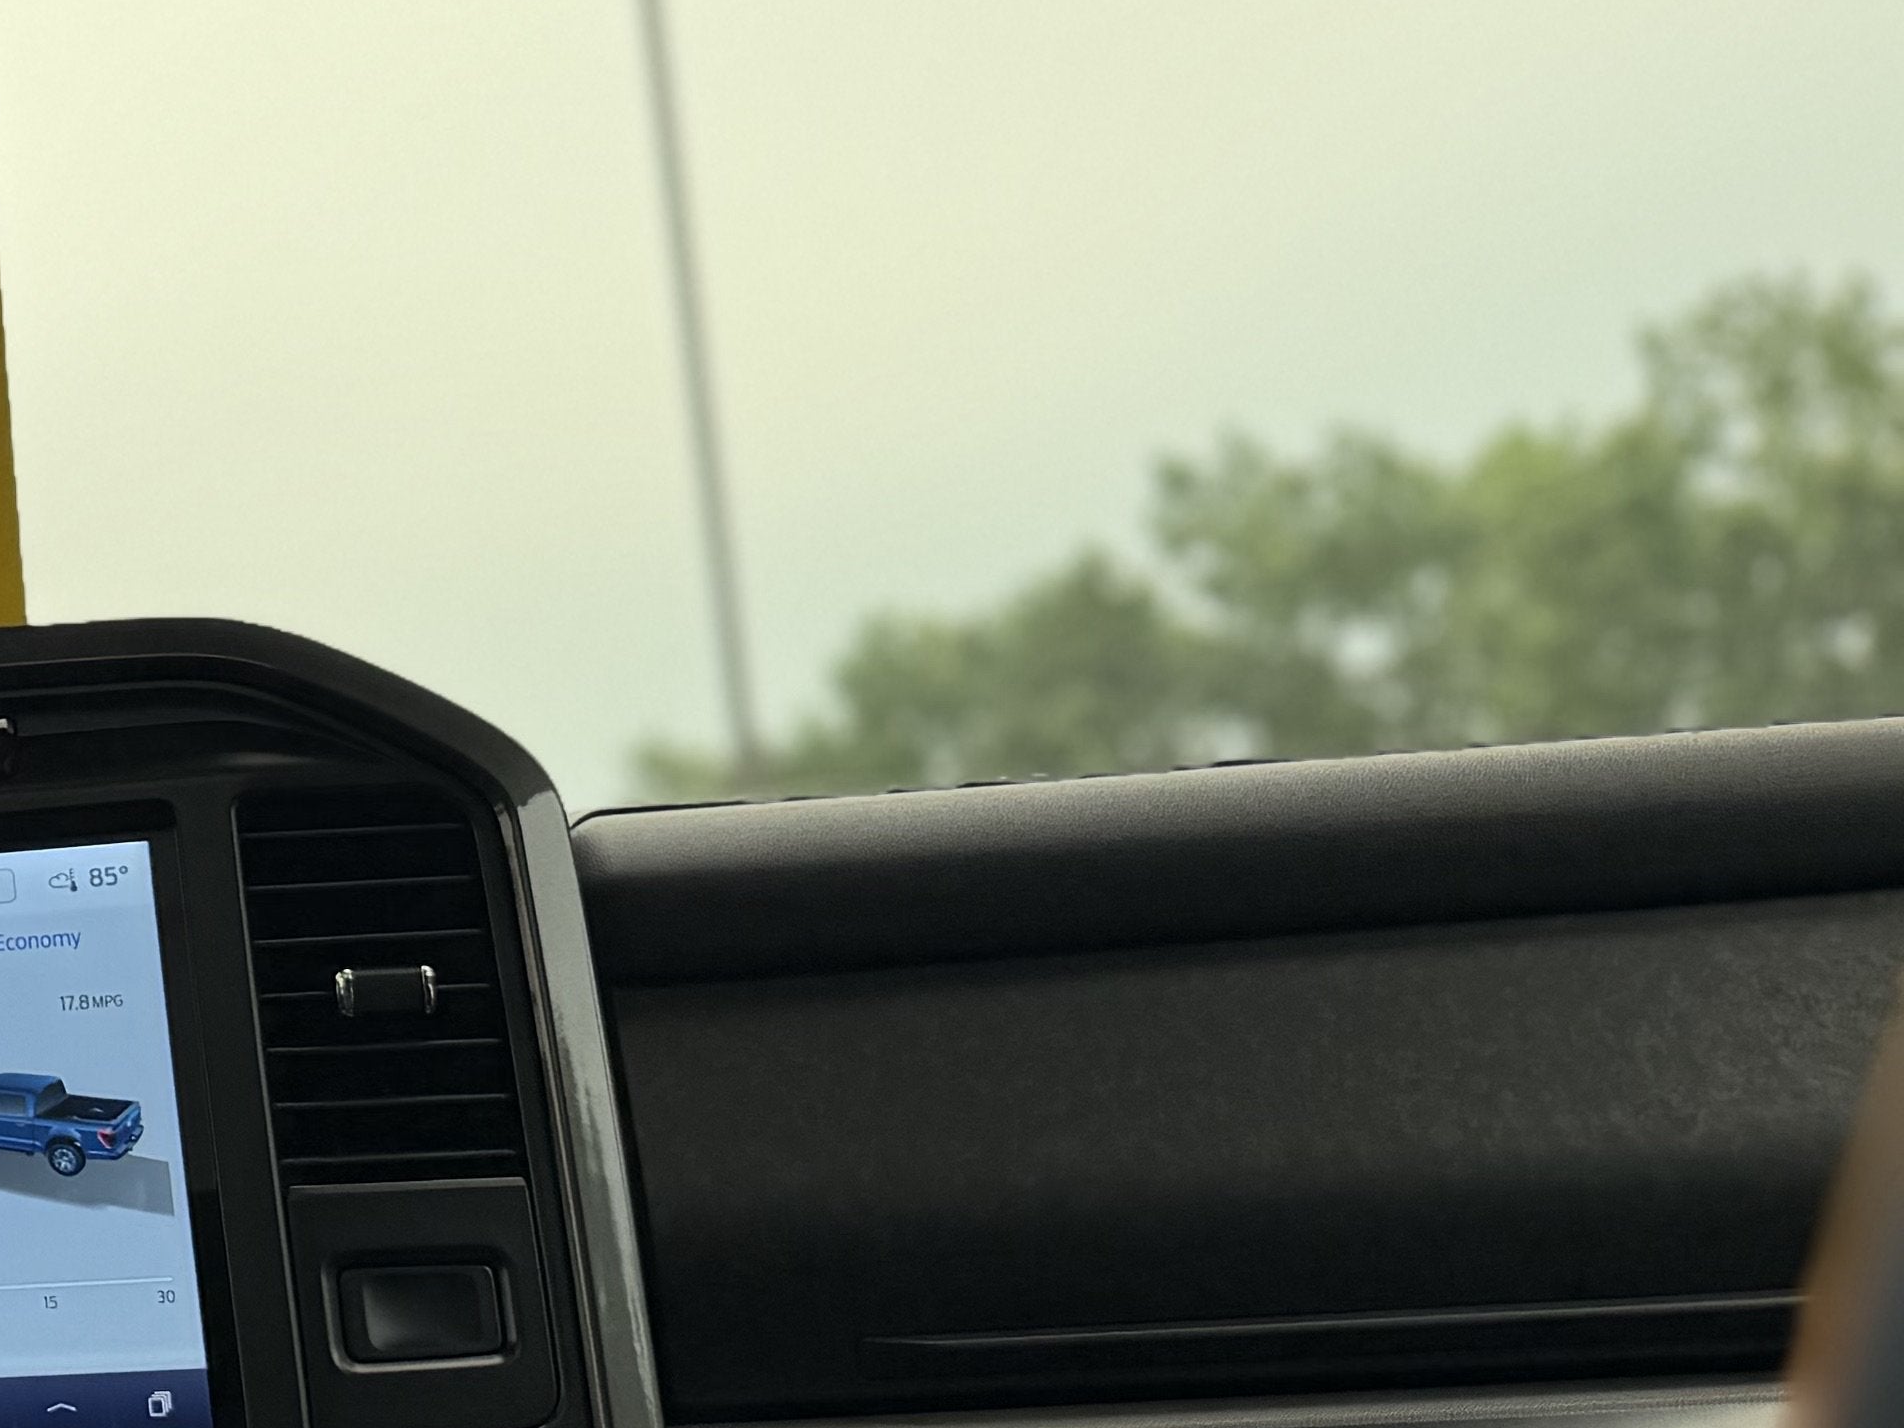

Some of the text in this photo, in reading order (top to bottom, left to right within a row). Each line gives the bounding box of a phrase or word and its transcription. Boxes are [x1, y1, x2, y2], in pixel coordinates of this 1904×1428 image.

[88, 865, 129, 888] 85°
[44, 1296, 59, 1310] 15
[157, 1290, 176, 1304] 30
